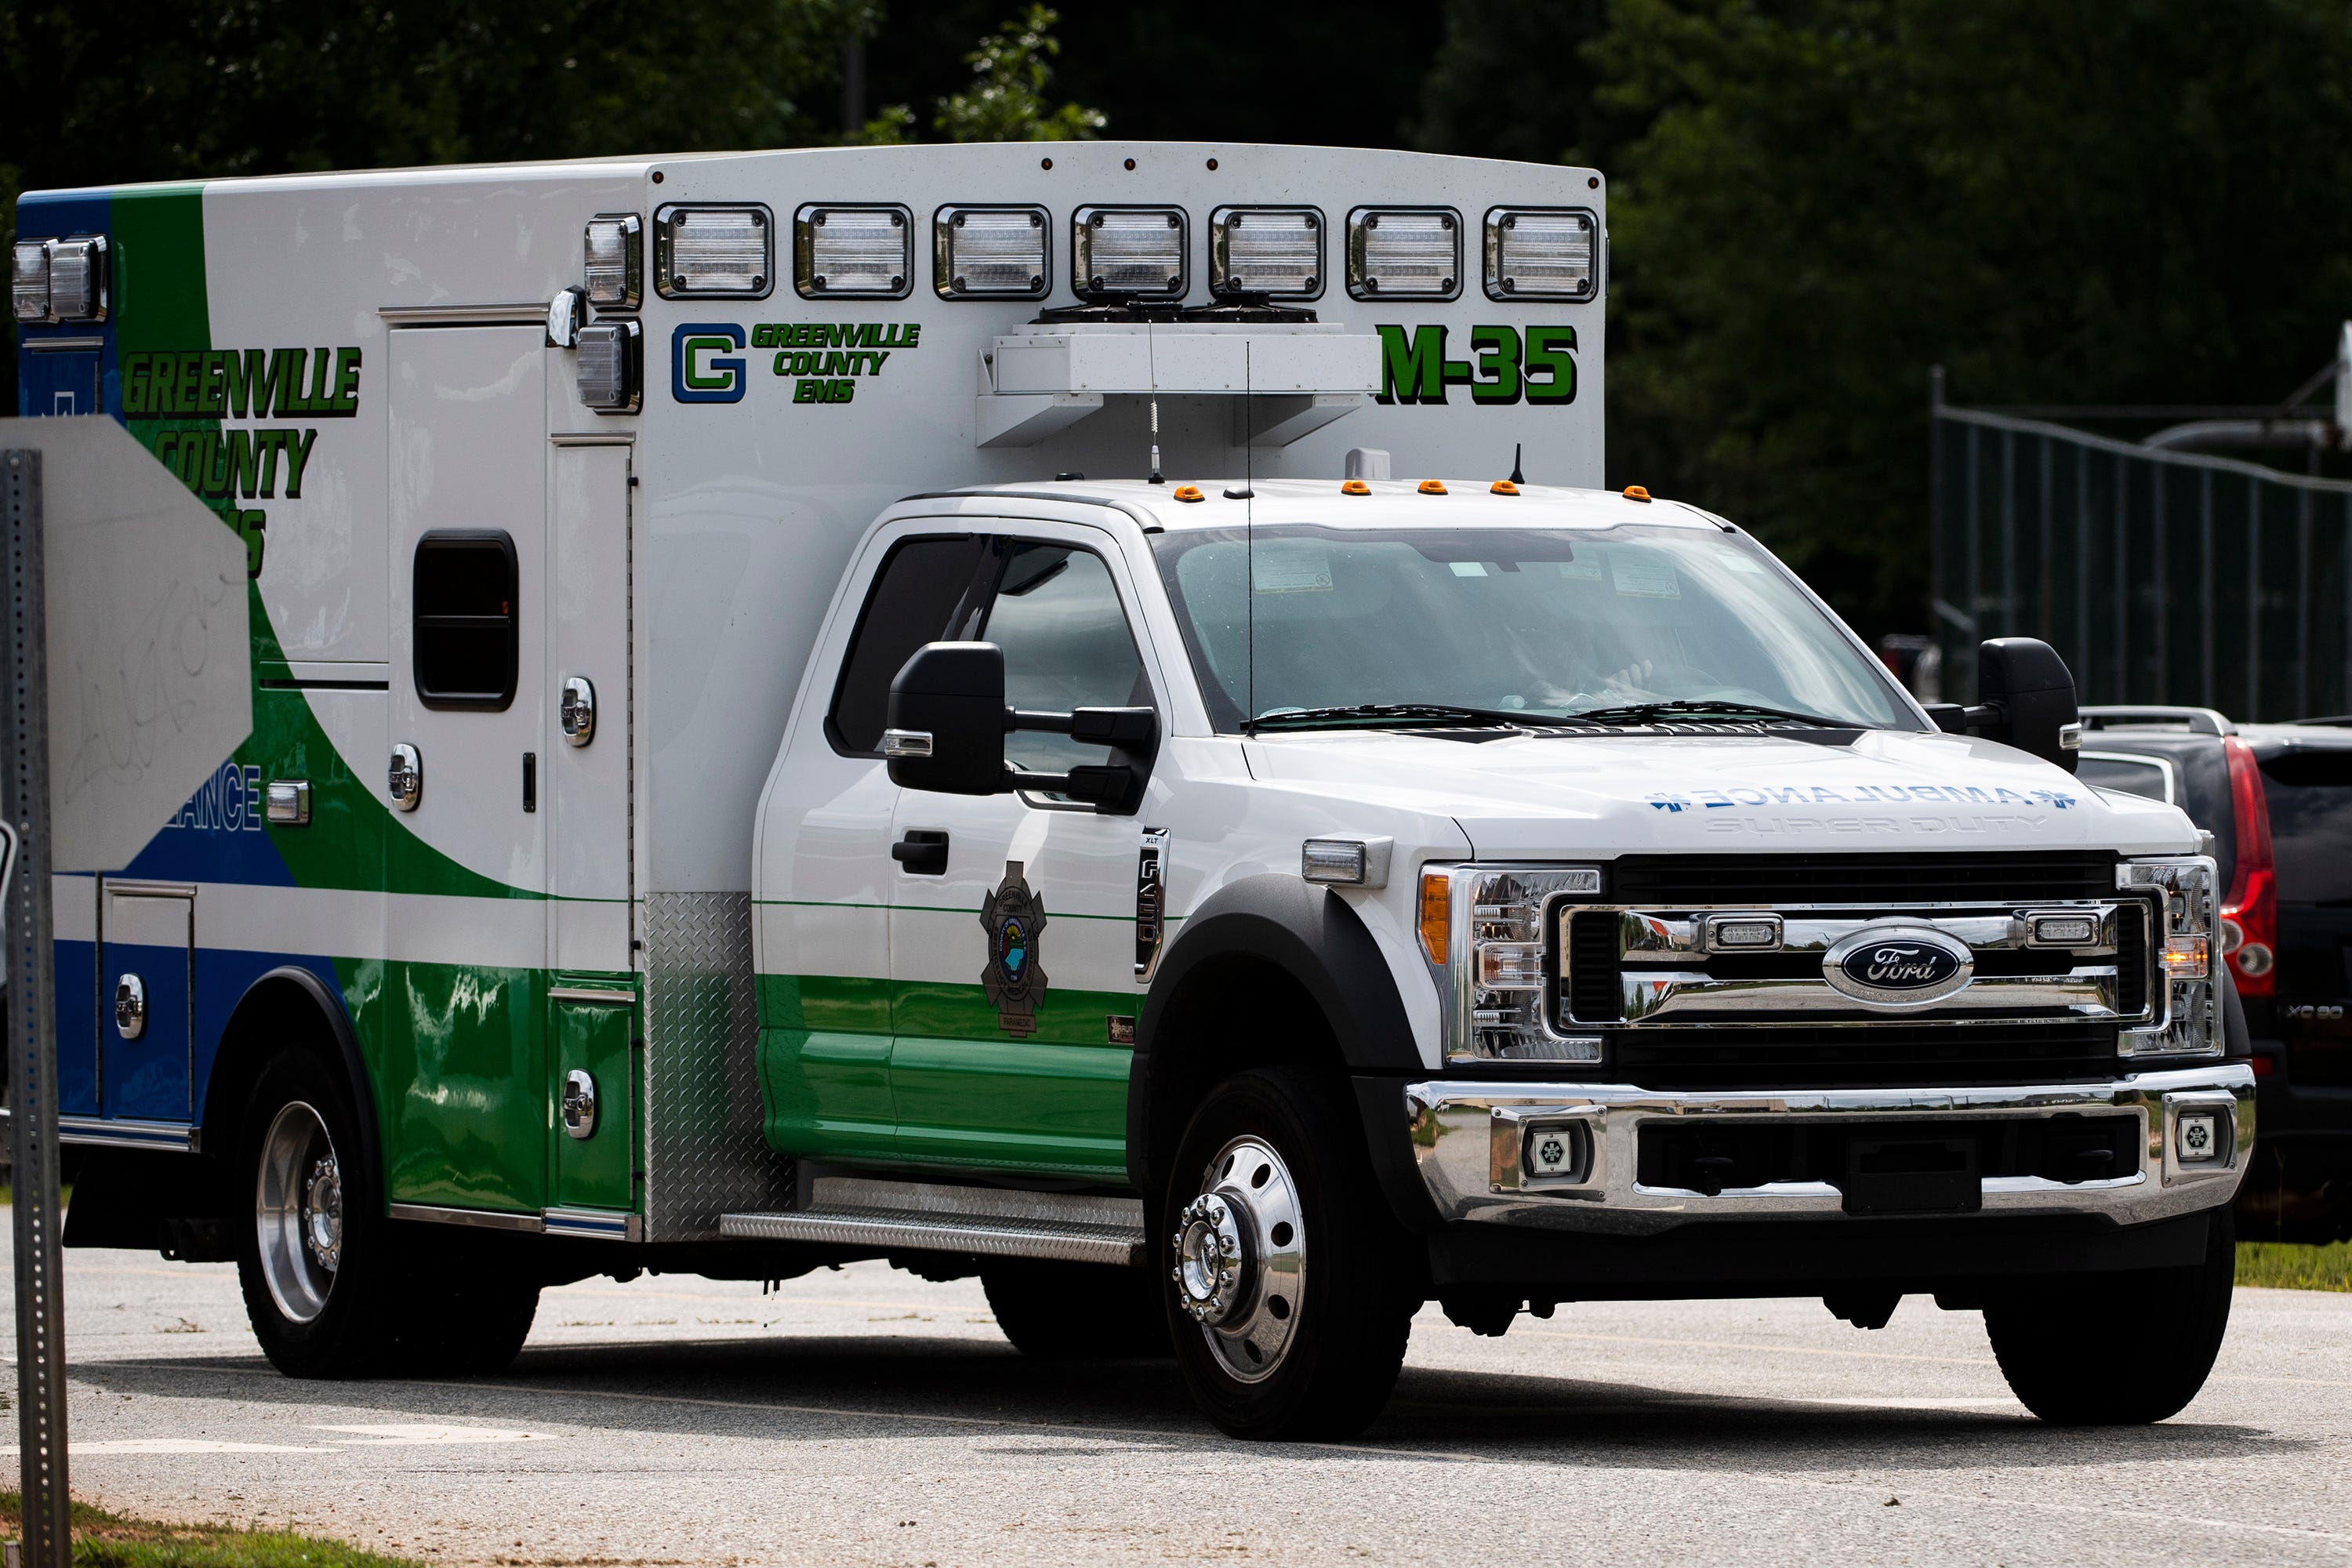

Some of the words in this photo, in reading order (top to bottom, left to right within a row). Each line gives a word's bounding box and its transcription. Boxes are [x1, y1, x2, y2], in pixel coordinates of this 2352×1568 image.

[751, 323, 921, 348] GREENVILLE
[772, 351, 891, 376] COUNTY
[1374, 324, 1578, 405] M-35
[122, 347, 362, 419] GREENVILLE
[792, 379, 855, 404] EMS
[1704, 817, 1901, 834] SUPER
[1909, 815, 2048, 833] DUTY
[1867, 948, 1937, 980] Ford
